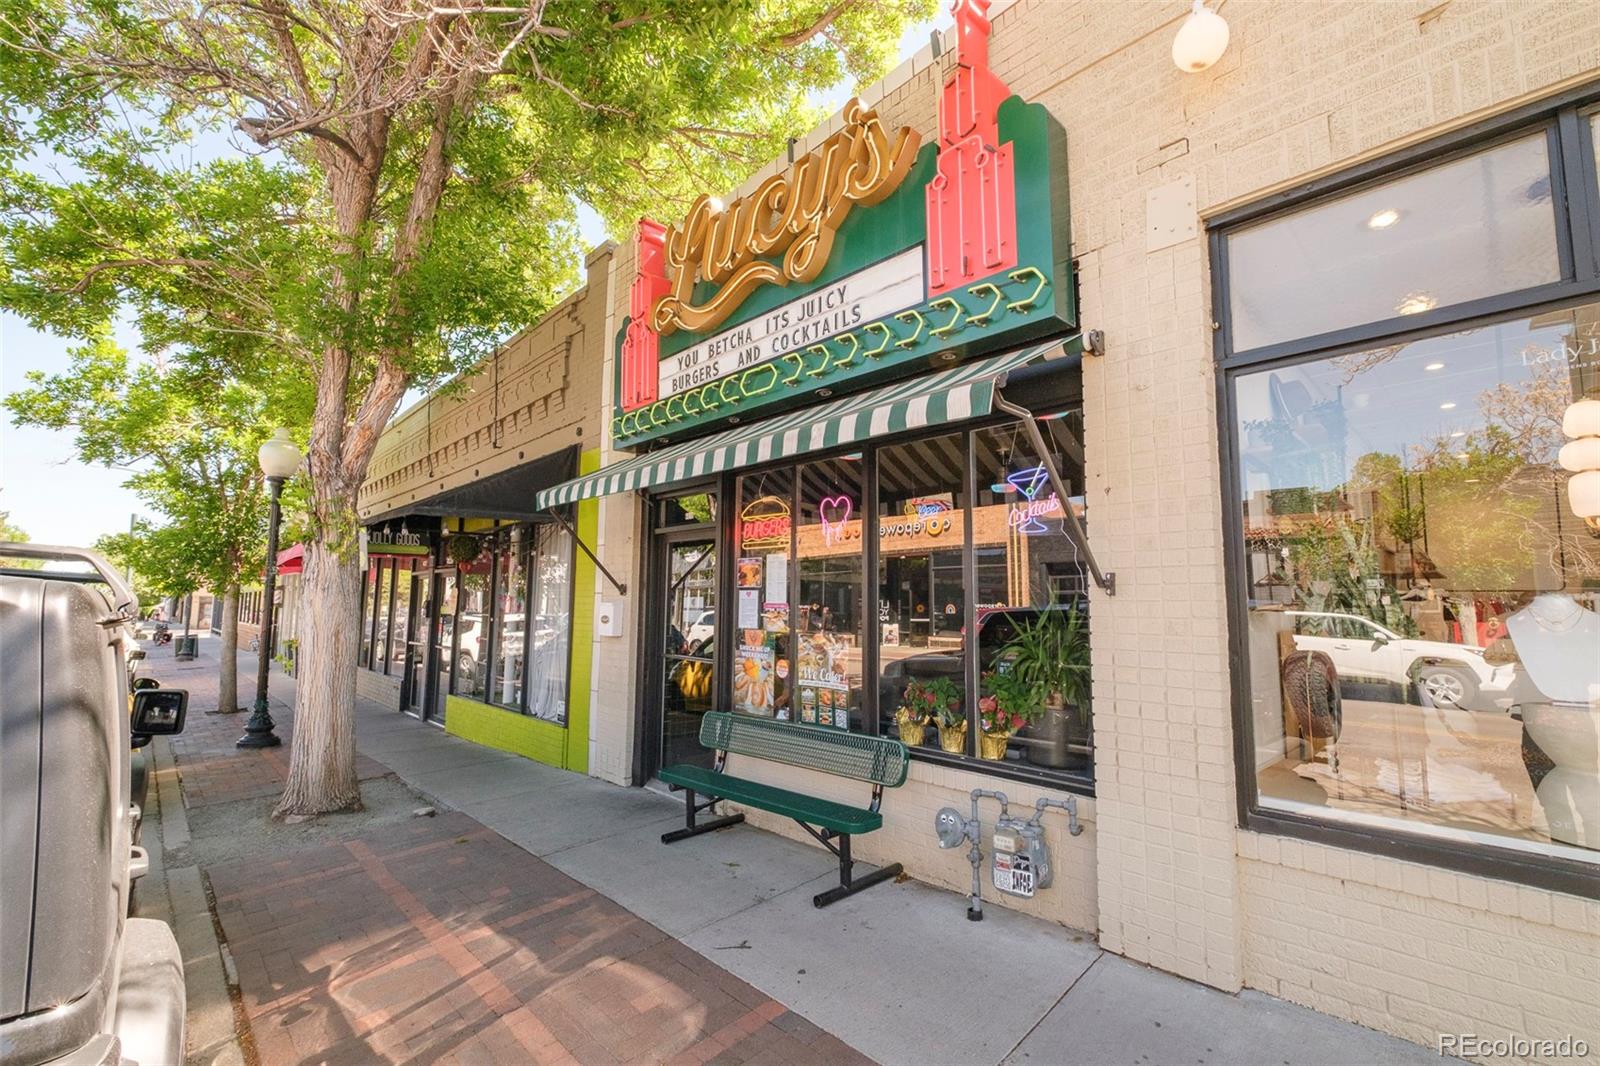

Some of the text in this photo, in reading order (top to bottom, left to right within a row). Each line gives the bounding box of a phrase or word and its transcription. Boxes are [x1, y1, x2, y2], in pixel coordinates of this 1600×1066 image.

[652, 97, 923, 334] Lucy's
[677, 285, 847, 371] YOU BETCHA ITS JUICY
[672, 303, 861, 392] BURGERS AND COCKTAILS
[1521, 341, 1584, 367] Lady
[1008, 491, 1060, 527] Cocktails
[369, 531, 421, 546] JOLLY GOODS
[743, 517, 791, 539] BURGERS
[802, 667, 818, 681] We
